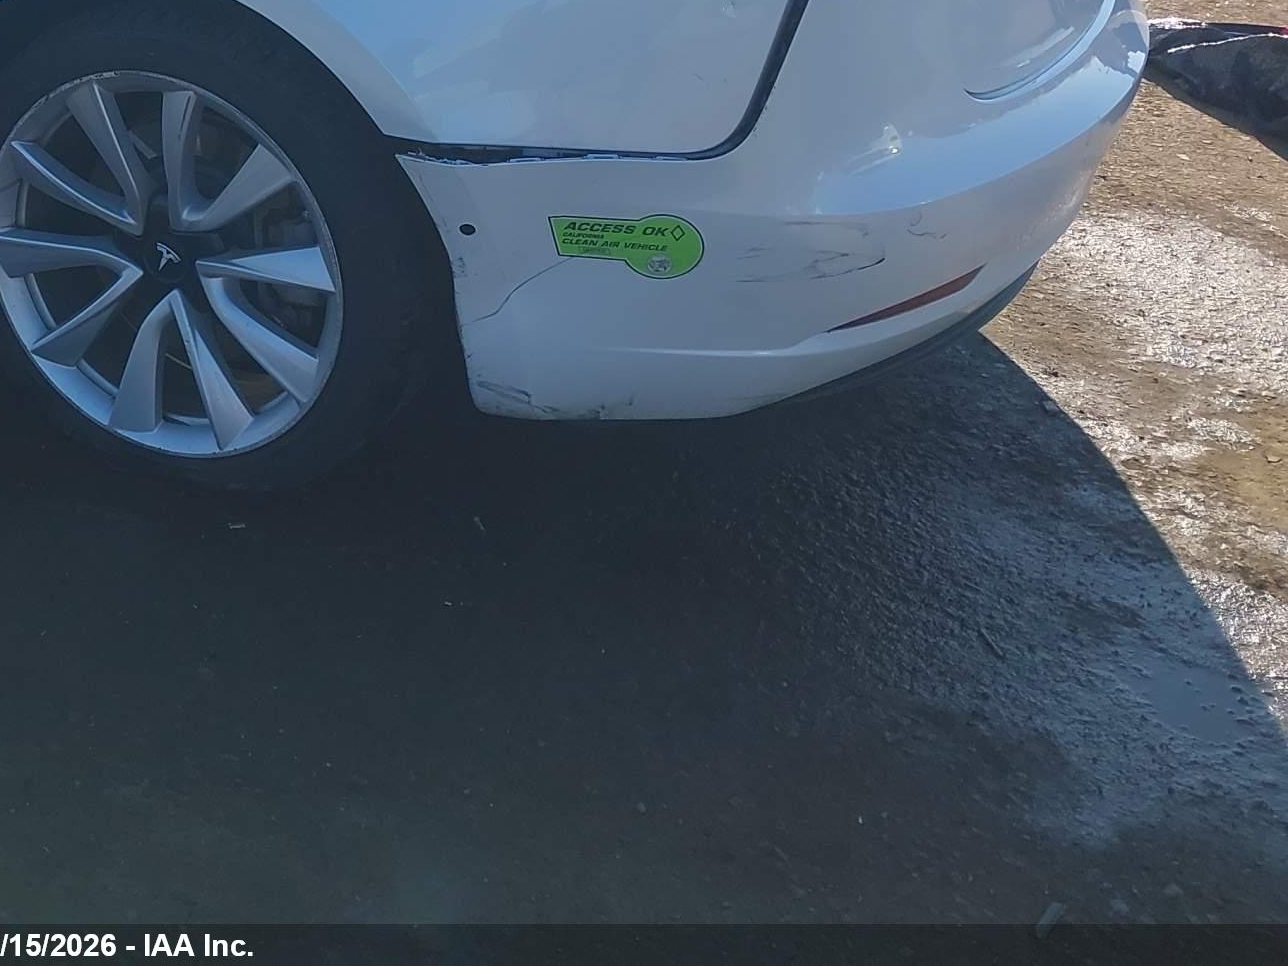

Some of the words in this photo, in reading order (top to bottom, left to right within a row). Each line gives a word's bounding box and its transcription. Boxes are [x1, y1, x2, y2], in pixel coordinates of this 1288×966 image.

[562, 231, 605, 240] CALIFORNIA
[564, 221, 637, 234] ACCESS
[642, 226, 669, 237] OK
[562, 238, 599, 246] CLEAN
[600, 240, 620, 249] AIR
[623, 242, 669, 252] VEHICLE
